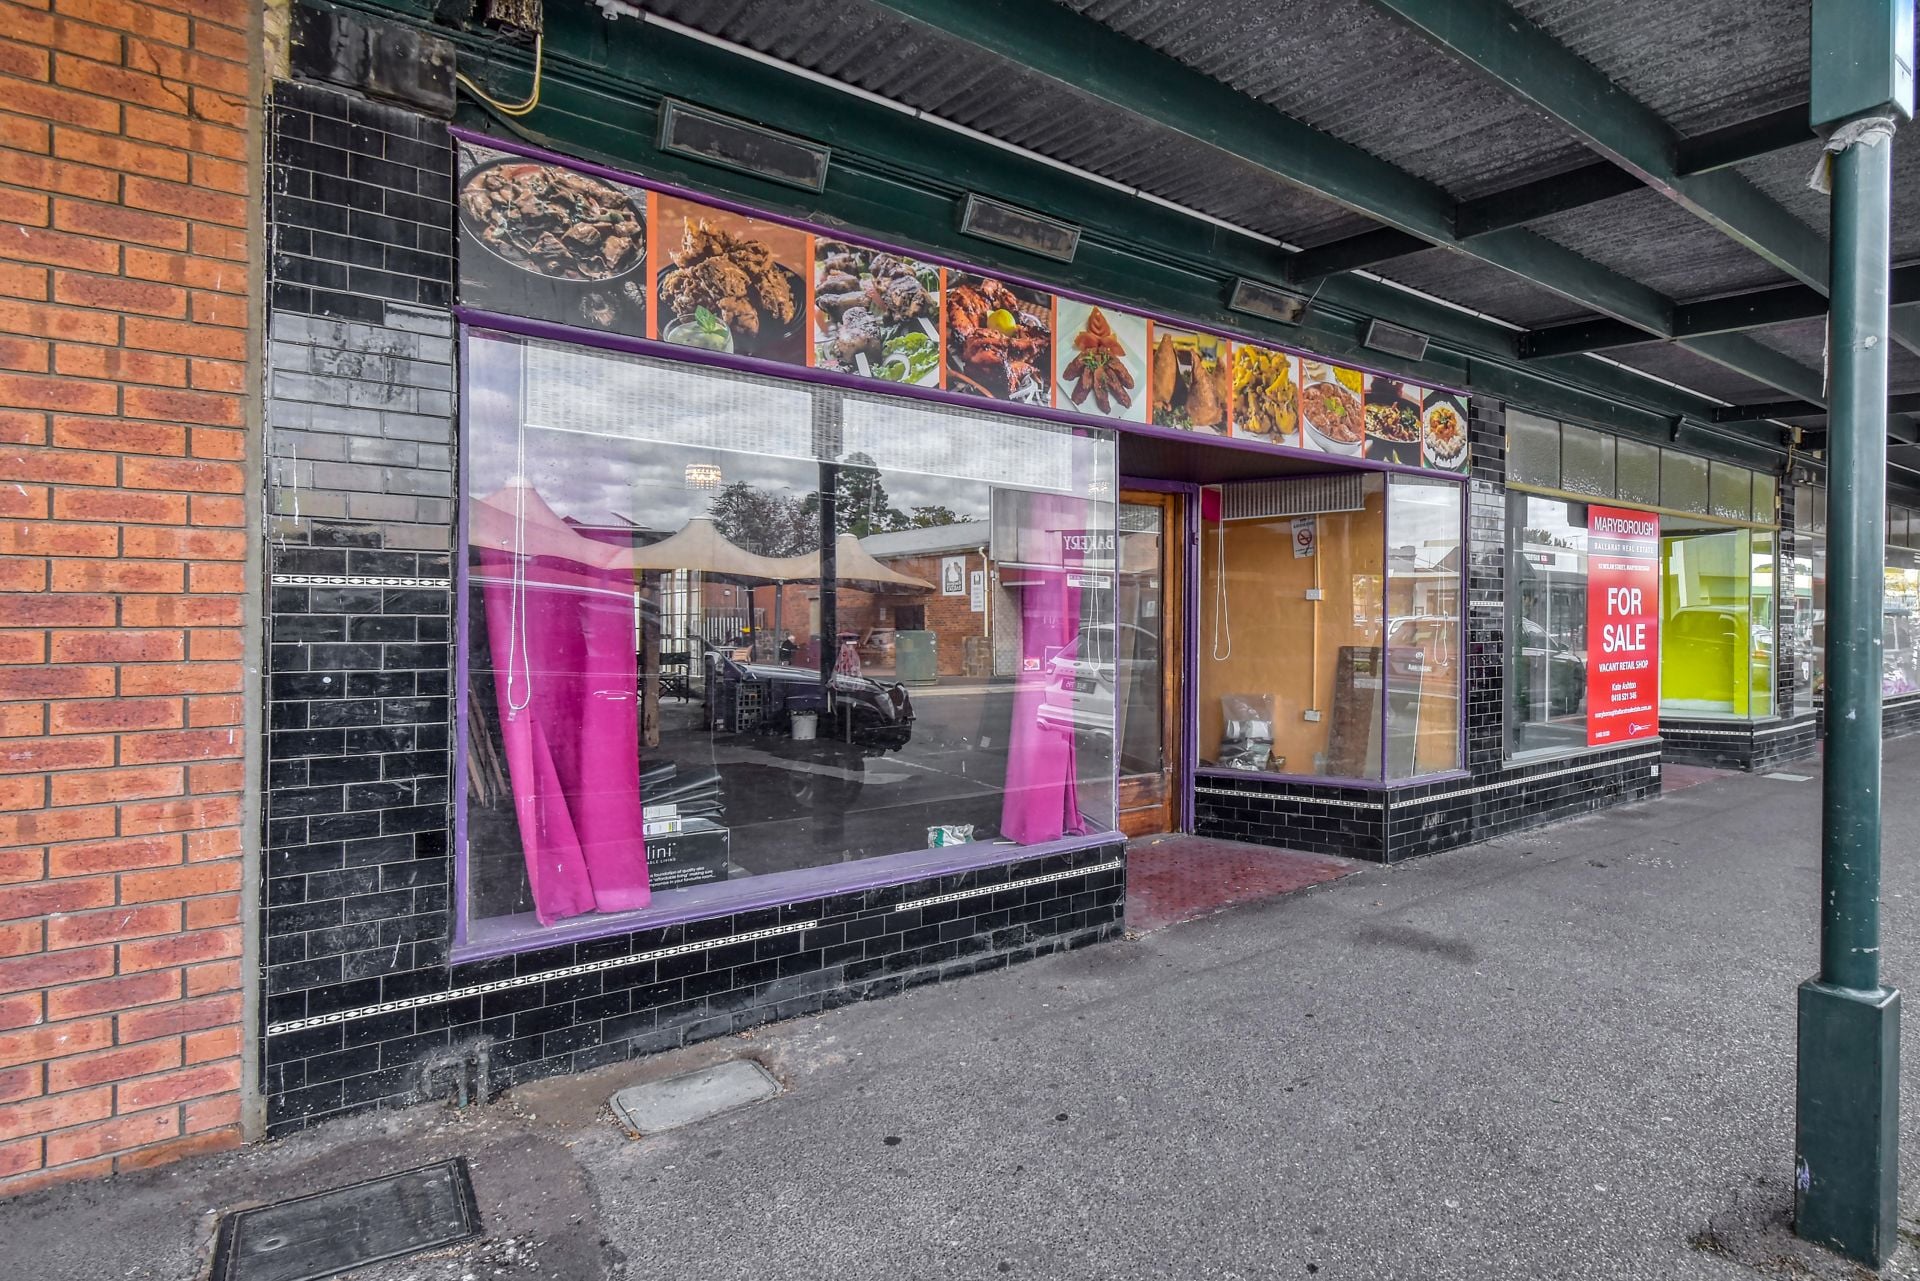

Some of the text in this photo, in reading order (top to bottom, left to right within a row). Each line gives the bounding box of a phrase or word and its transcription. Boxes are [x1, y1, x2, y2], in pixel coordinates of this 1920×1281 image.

[1594, 516, 1654, 536] MARYBOROUGH
[1594, 542, 1620, 551] BALLARAT
[1622, 544, 1635, 552] REAL
[1607, 587, 1642, 615] FOR
[1602, 623, 1646, 653] SALE
[1599, 660, 1649, 672] VACANT RETAIL SHOP
[1611, 683, 1621, 691] Kate
[646, 843, 672, 860] lini
